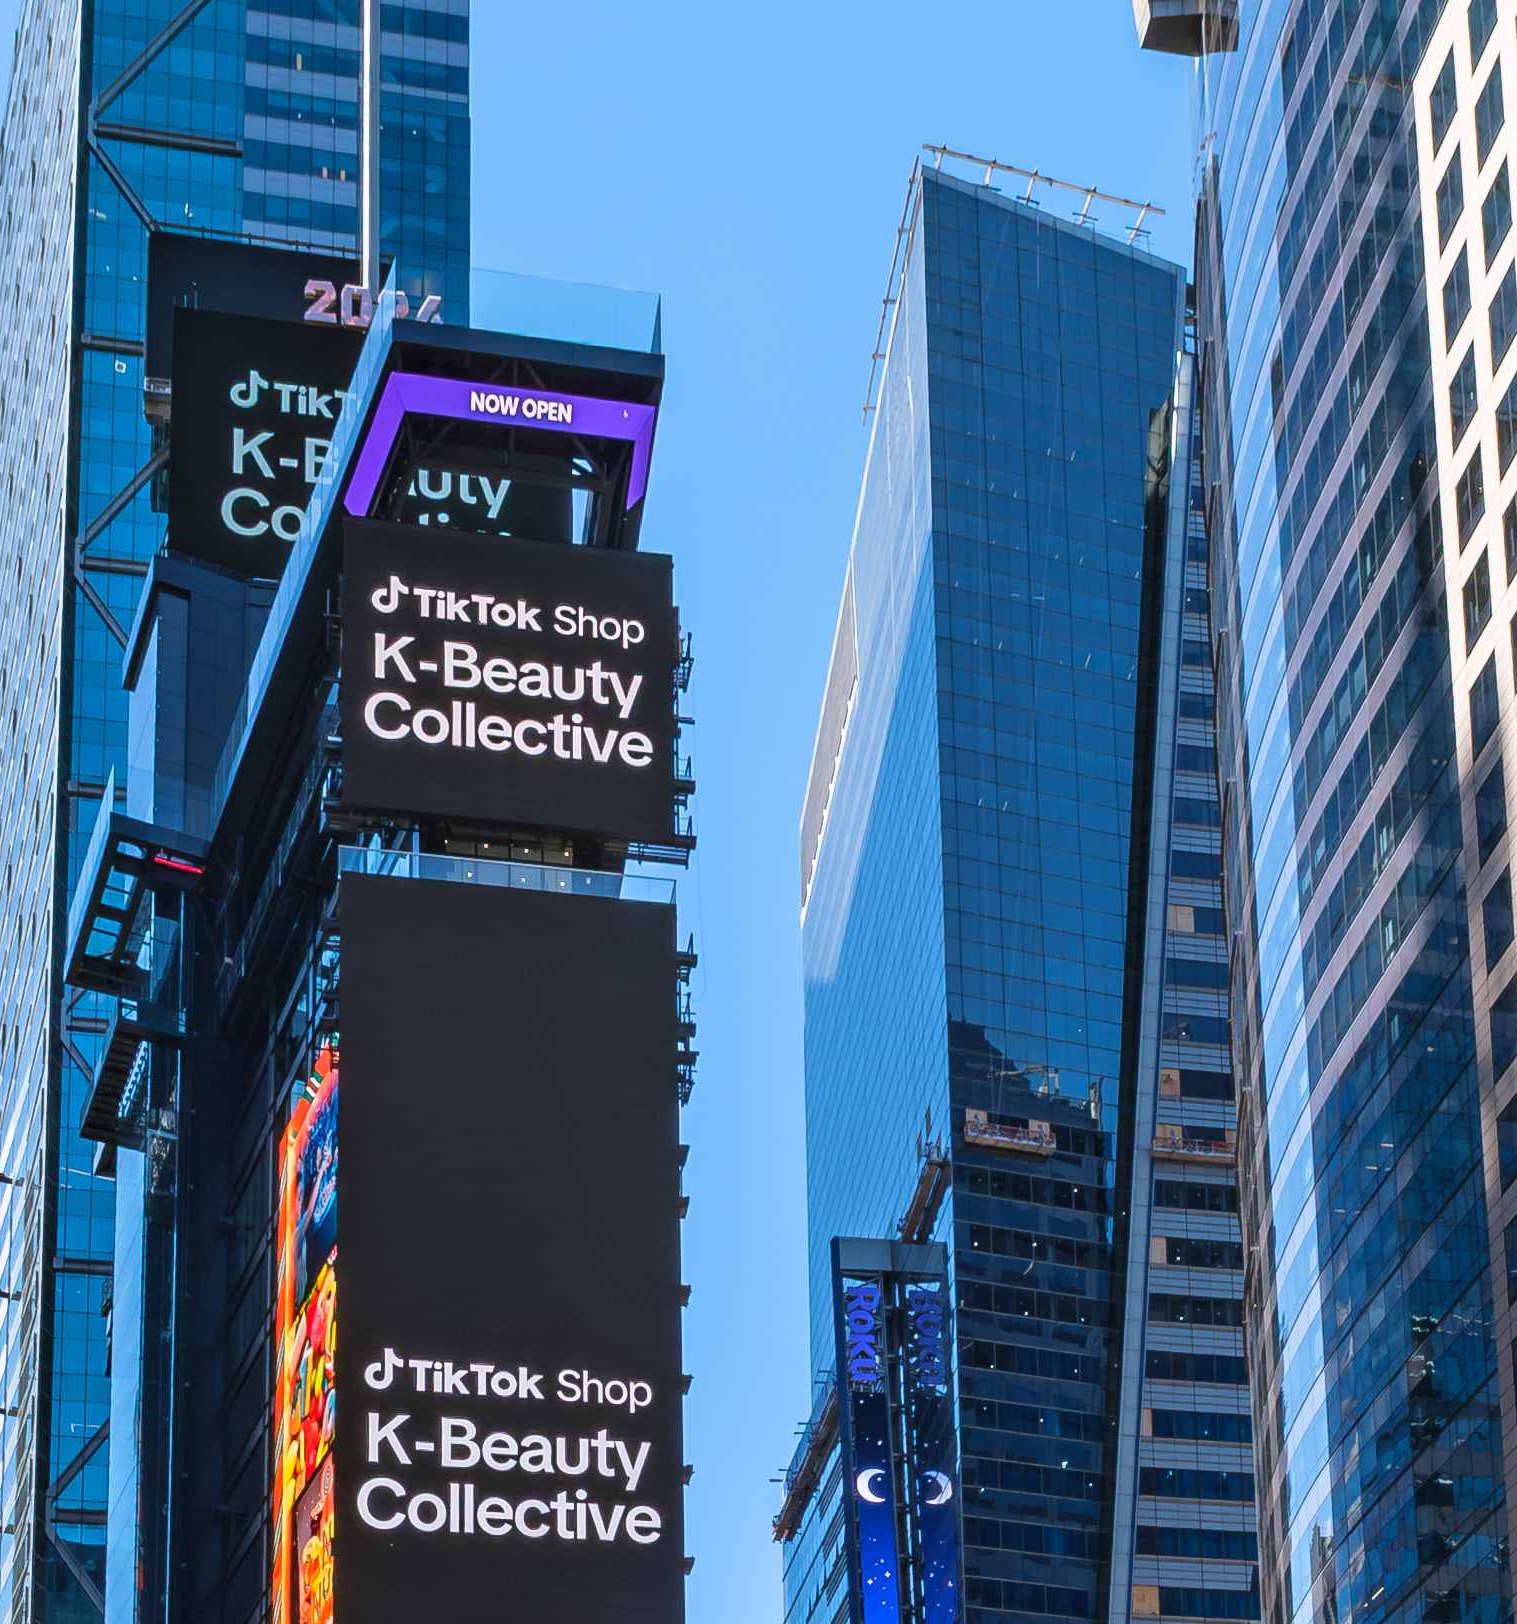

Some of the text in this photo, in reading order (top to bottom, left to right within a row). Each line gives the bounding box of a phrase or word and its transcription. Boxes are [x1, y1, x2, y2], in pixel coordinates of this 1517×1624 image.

[470, 390, 573, 425] NOW OPEN
[414, 587, 645, 649] TikTok Shop
[372, 632, 643, 719] K-Beauty
[364, 692, 654, 768] Collective
[846, 1286, 881, 1381] ROKU
[409, 1358, 653, 1414] TikTok Shop
[366, 1412, 651, 1493] K-Beauty
[356, 1476, 661, 1544] Collective
